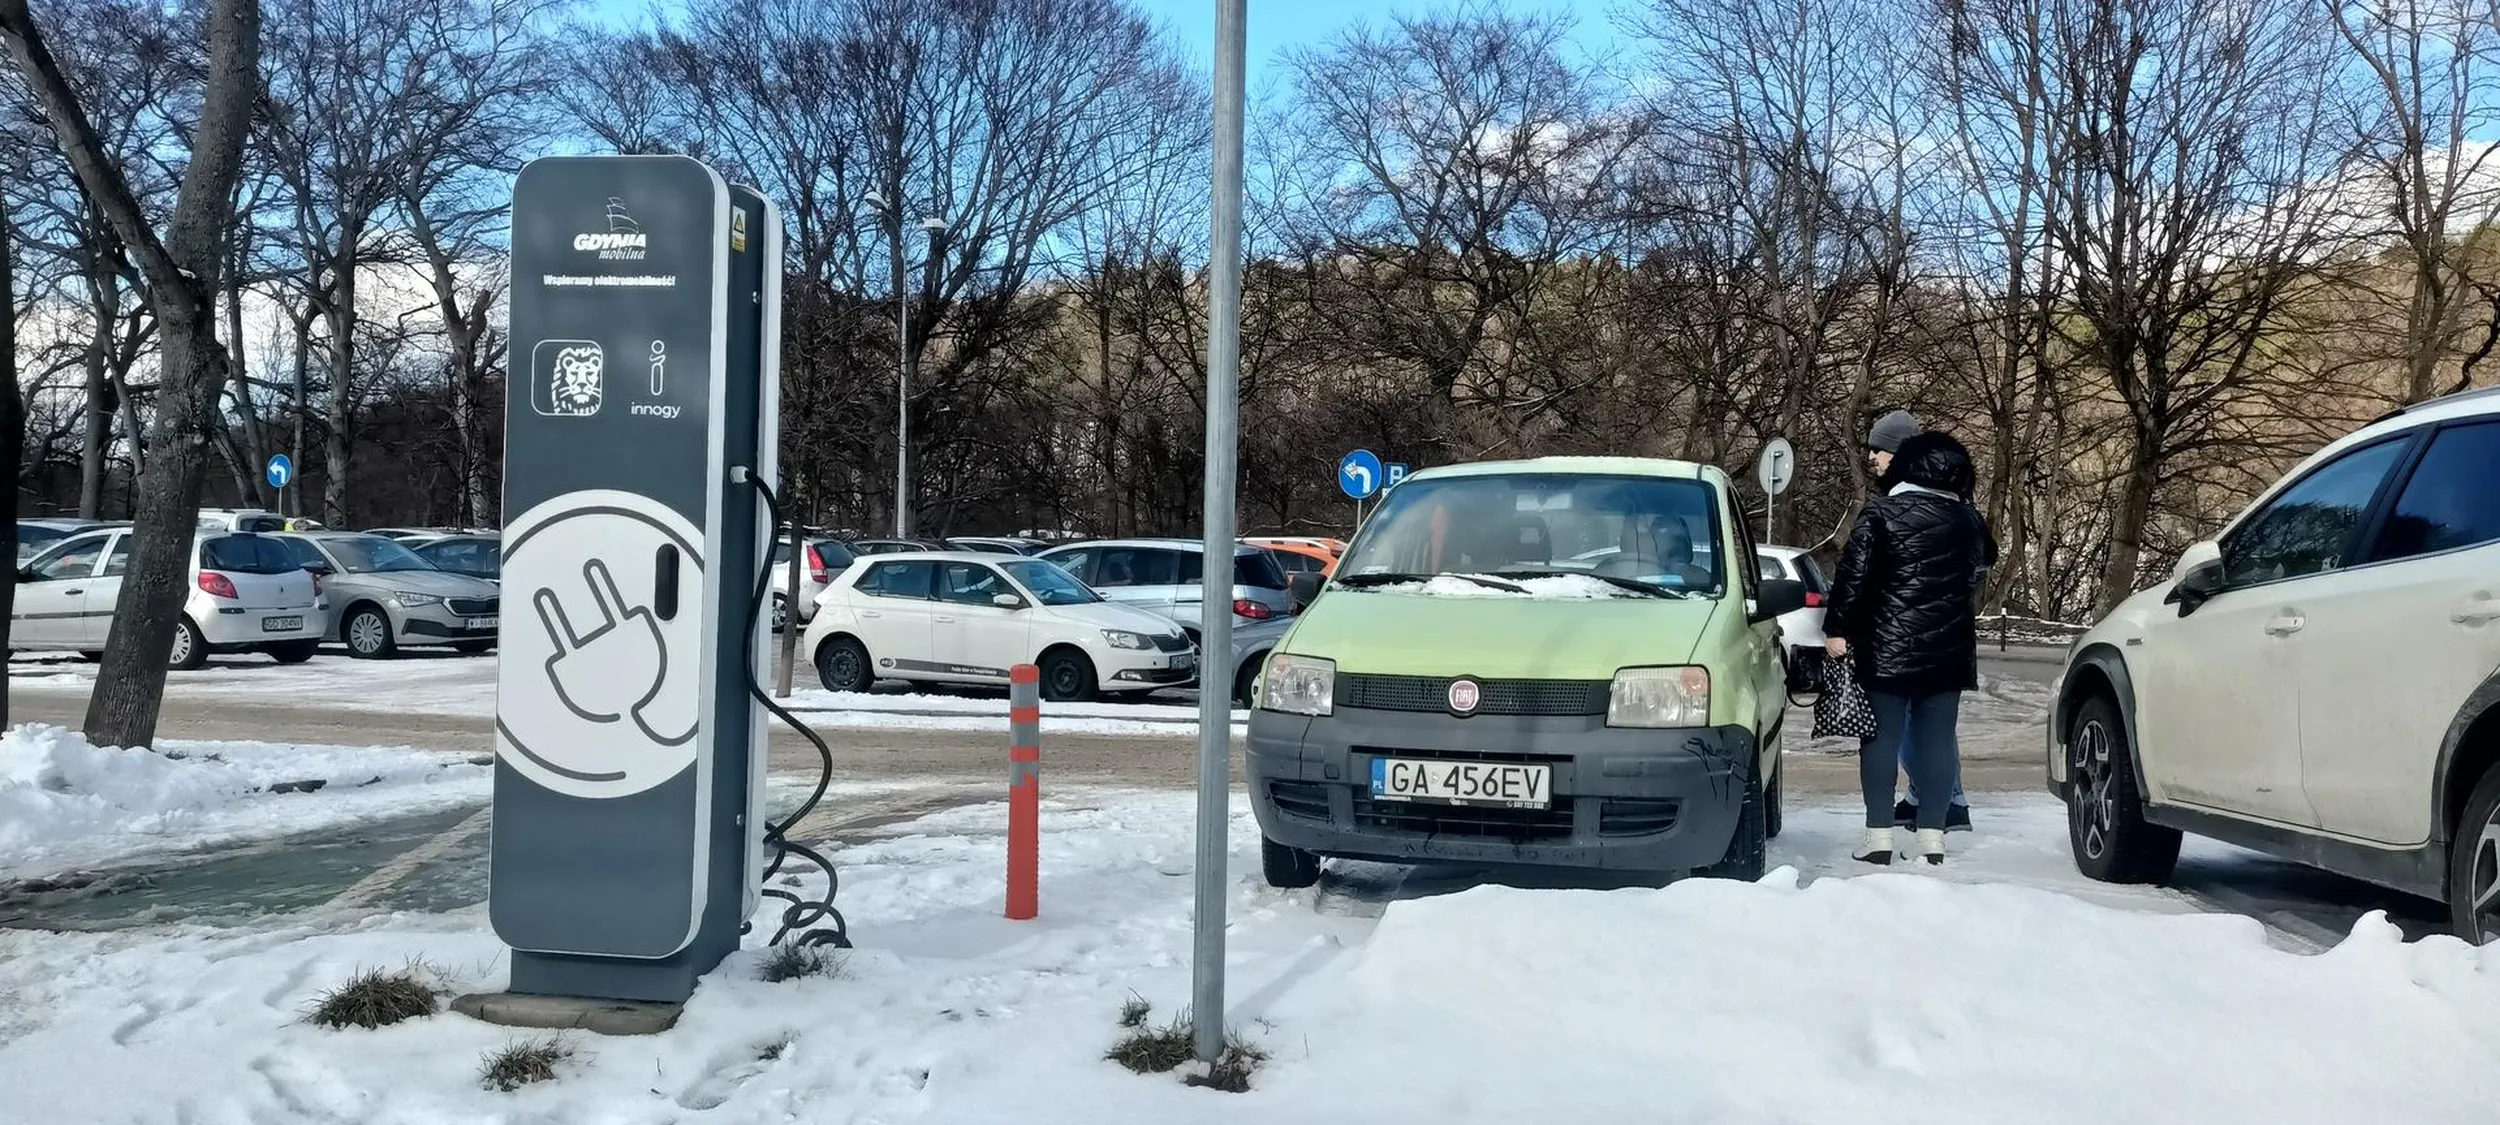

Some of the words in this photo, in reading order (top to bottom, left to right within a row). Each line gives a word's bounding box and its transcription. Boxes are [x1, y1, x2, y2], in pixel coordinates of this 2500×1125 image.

[573, 233, 646, 250] GDYNIA
[598, 246, 646, 260] mobilna
[543, 274, 593, 286] Wspieramy
[631, 401, 681, 419] innogy
[1390, 465, 1403, 485] P
[1392, 762, 1429, 795] GA
[1443, 765, 1542, 799] 456EV
